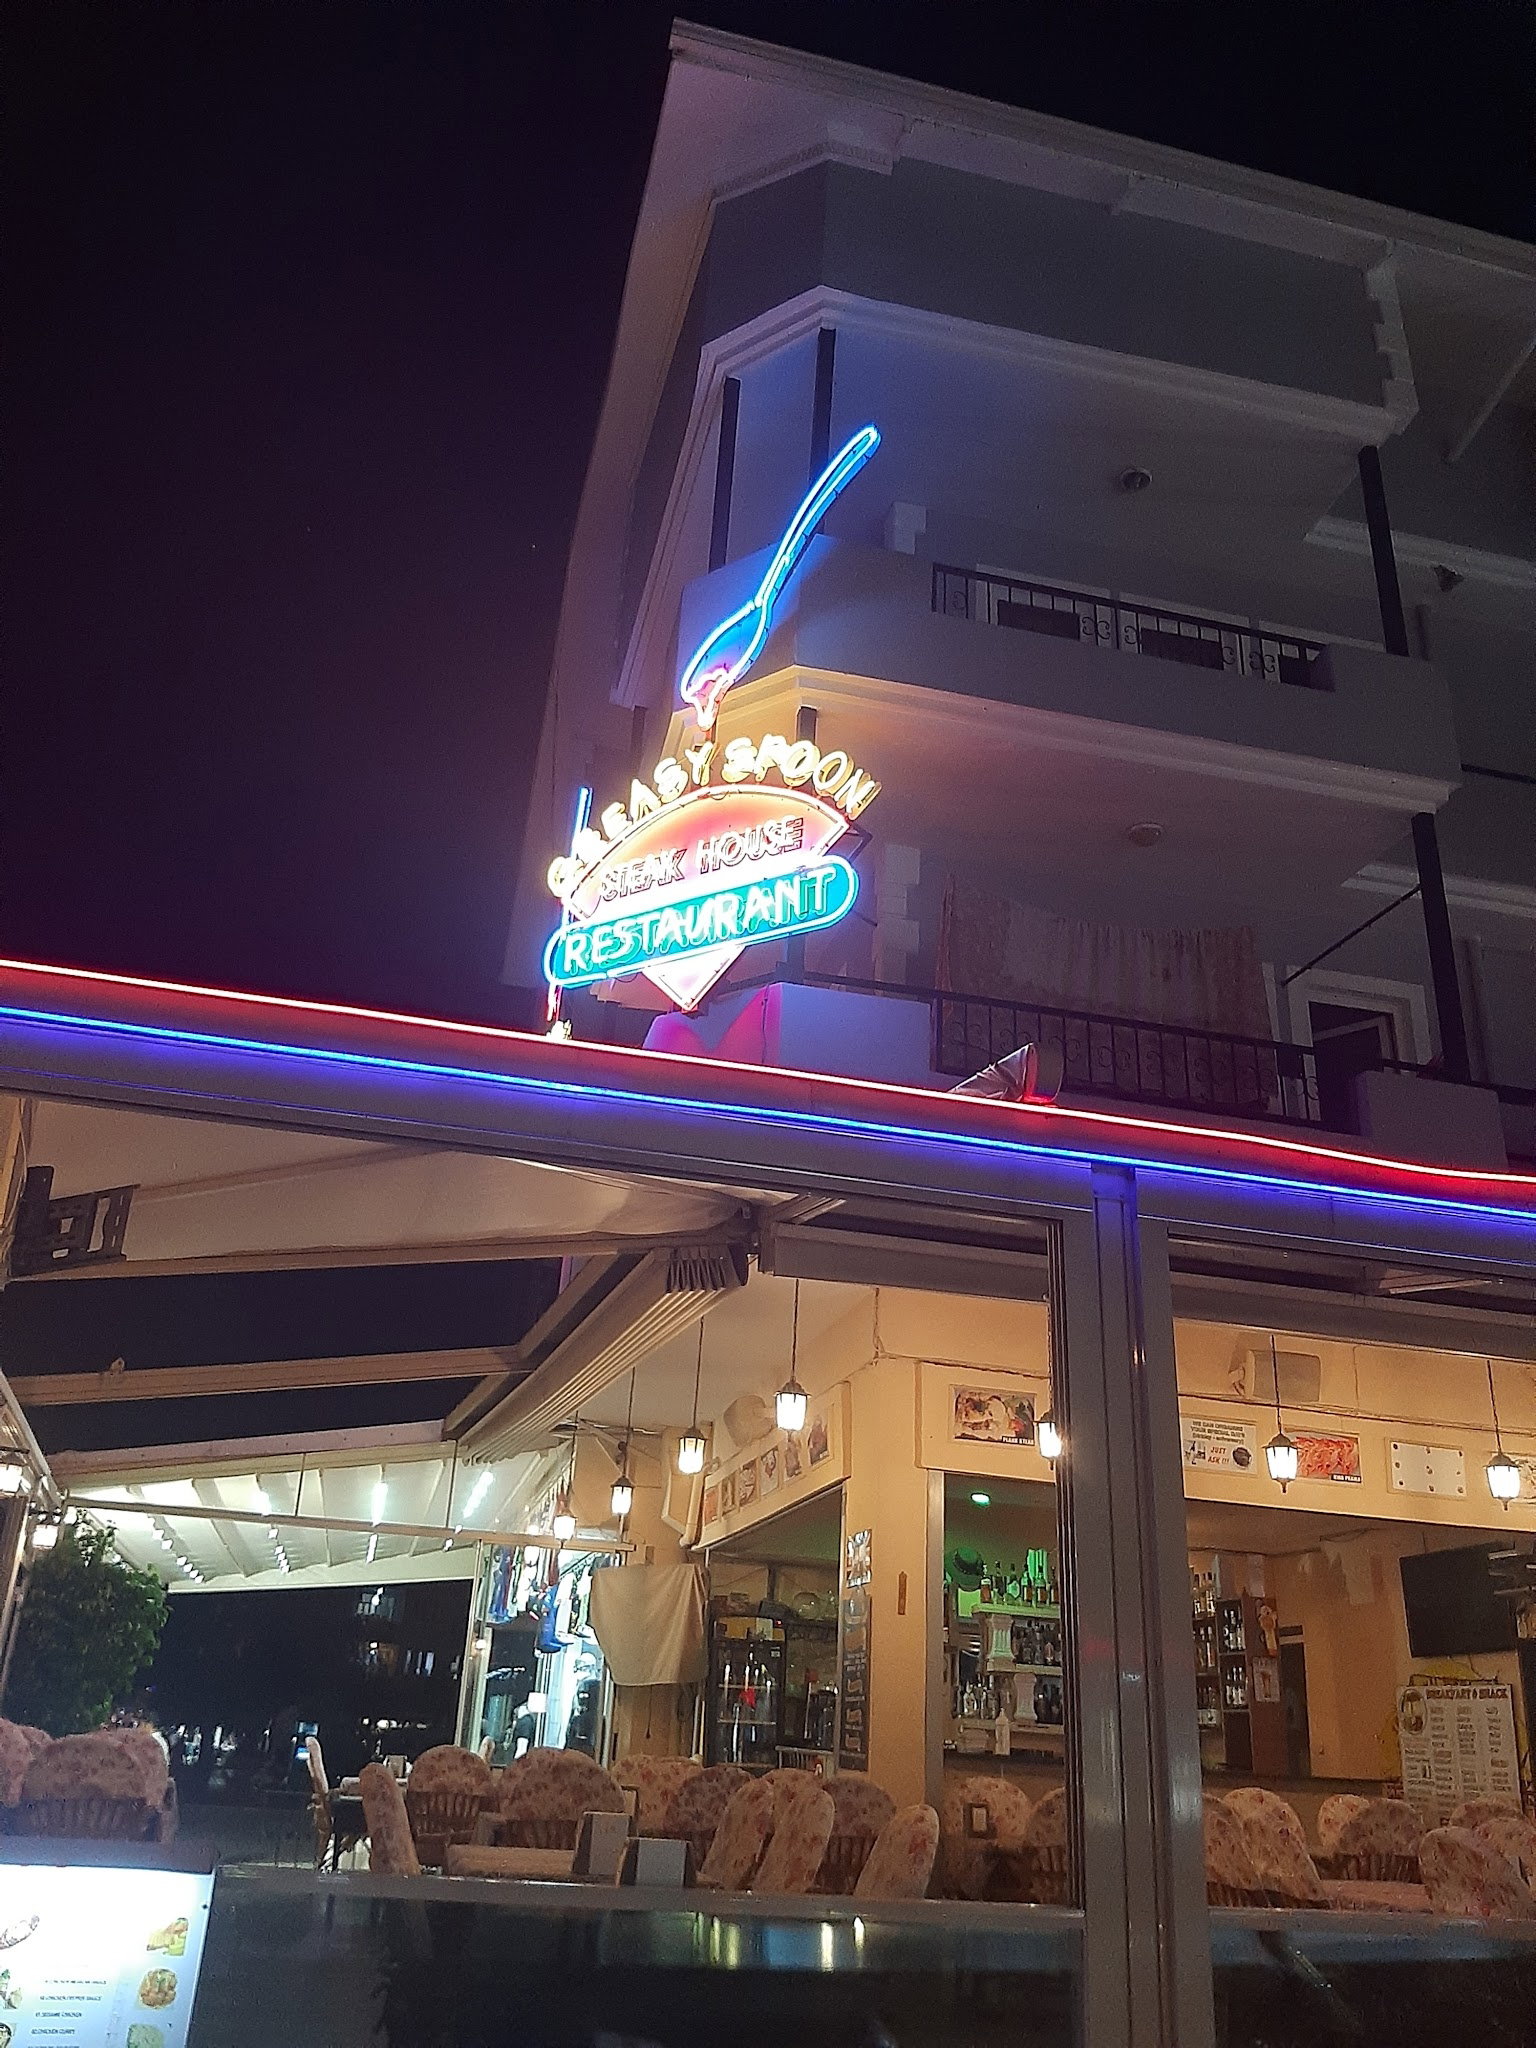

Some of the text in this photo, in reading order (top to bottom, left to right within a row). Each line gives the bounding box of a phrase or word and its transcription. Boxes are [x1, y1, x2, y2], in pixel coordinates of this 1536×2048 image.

[721, 733, 882, 820] SPOON
[600, 814, 804, 901] STEAK HOUSE
[563, 865, 838, 976] RESTAURANT
[1208, 1456, 1221, 1464] ASK
[1211, 1446, 1227, 1455] JUST
